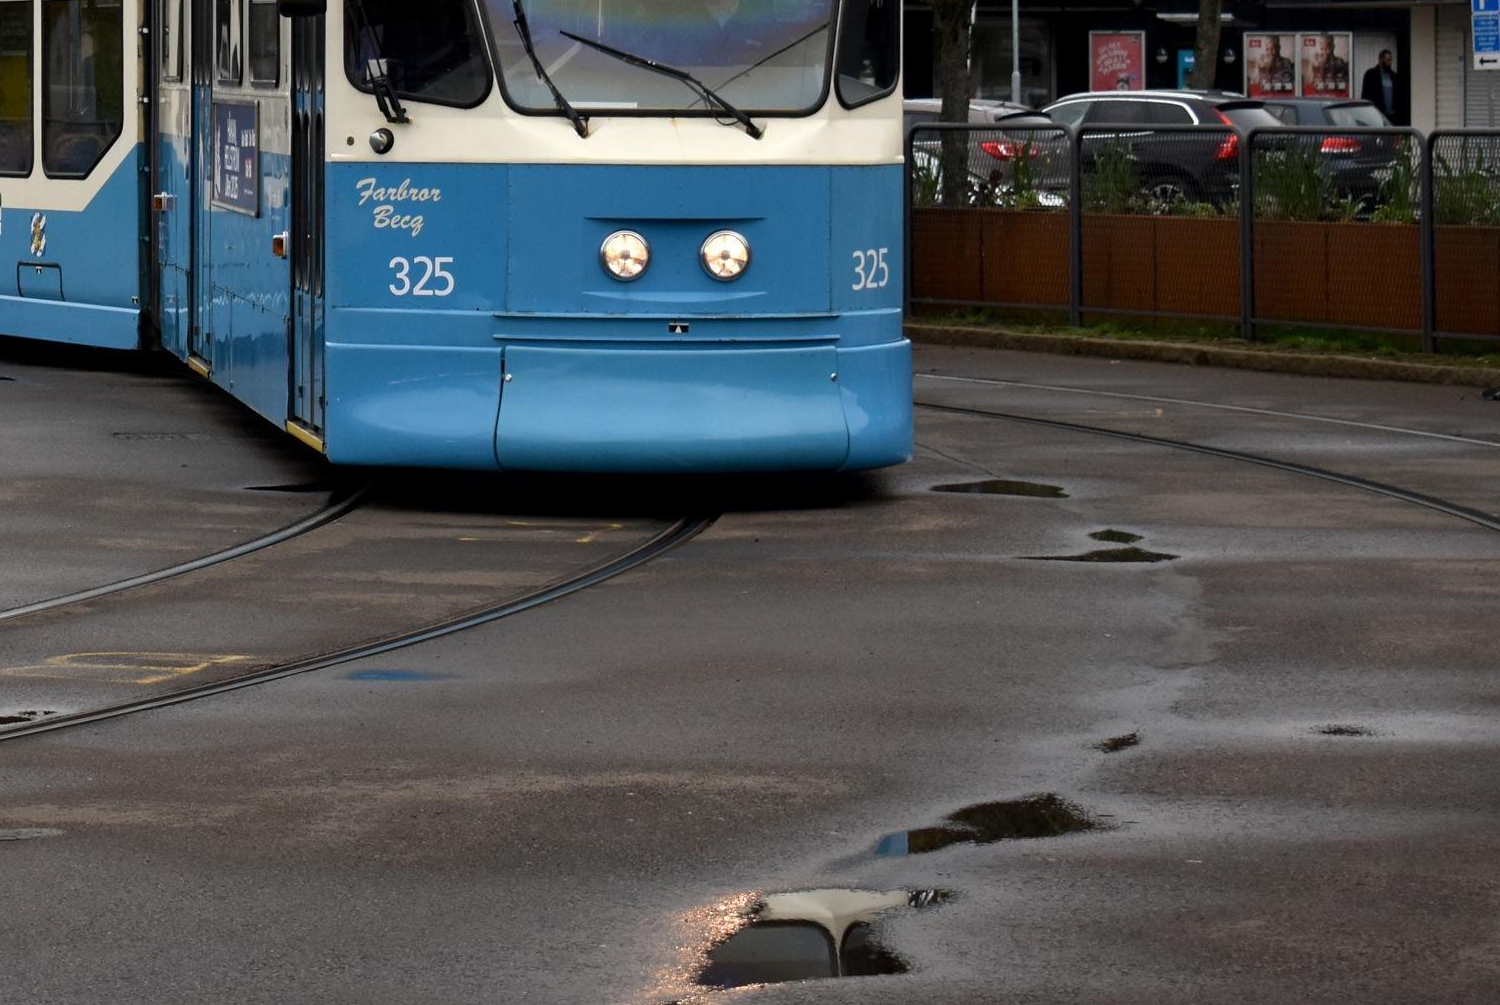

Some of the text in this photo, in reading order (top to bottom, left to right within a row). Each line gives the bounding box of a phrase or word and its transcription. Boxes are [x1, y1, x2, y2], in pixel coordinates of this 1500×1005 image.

[356, 178, 441, 206] Farbror
[389, 256, 455, 296] 325
[852, 247, 888, 291] 325
